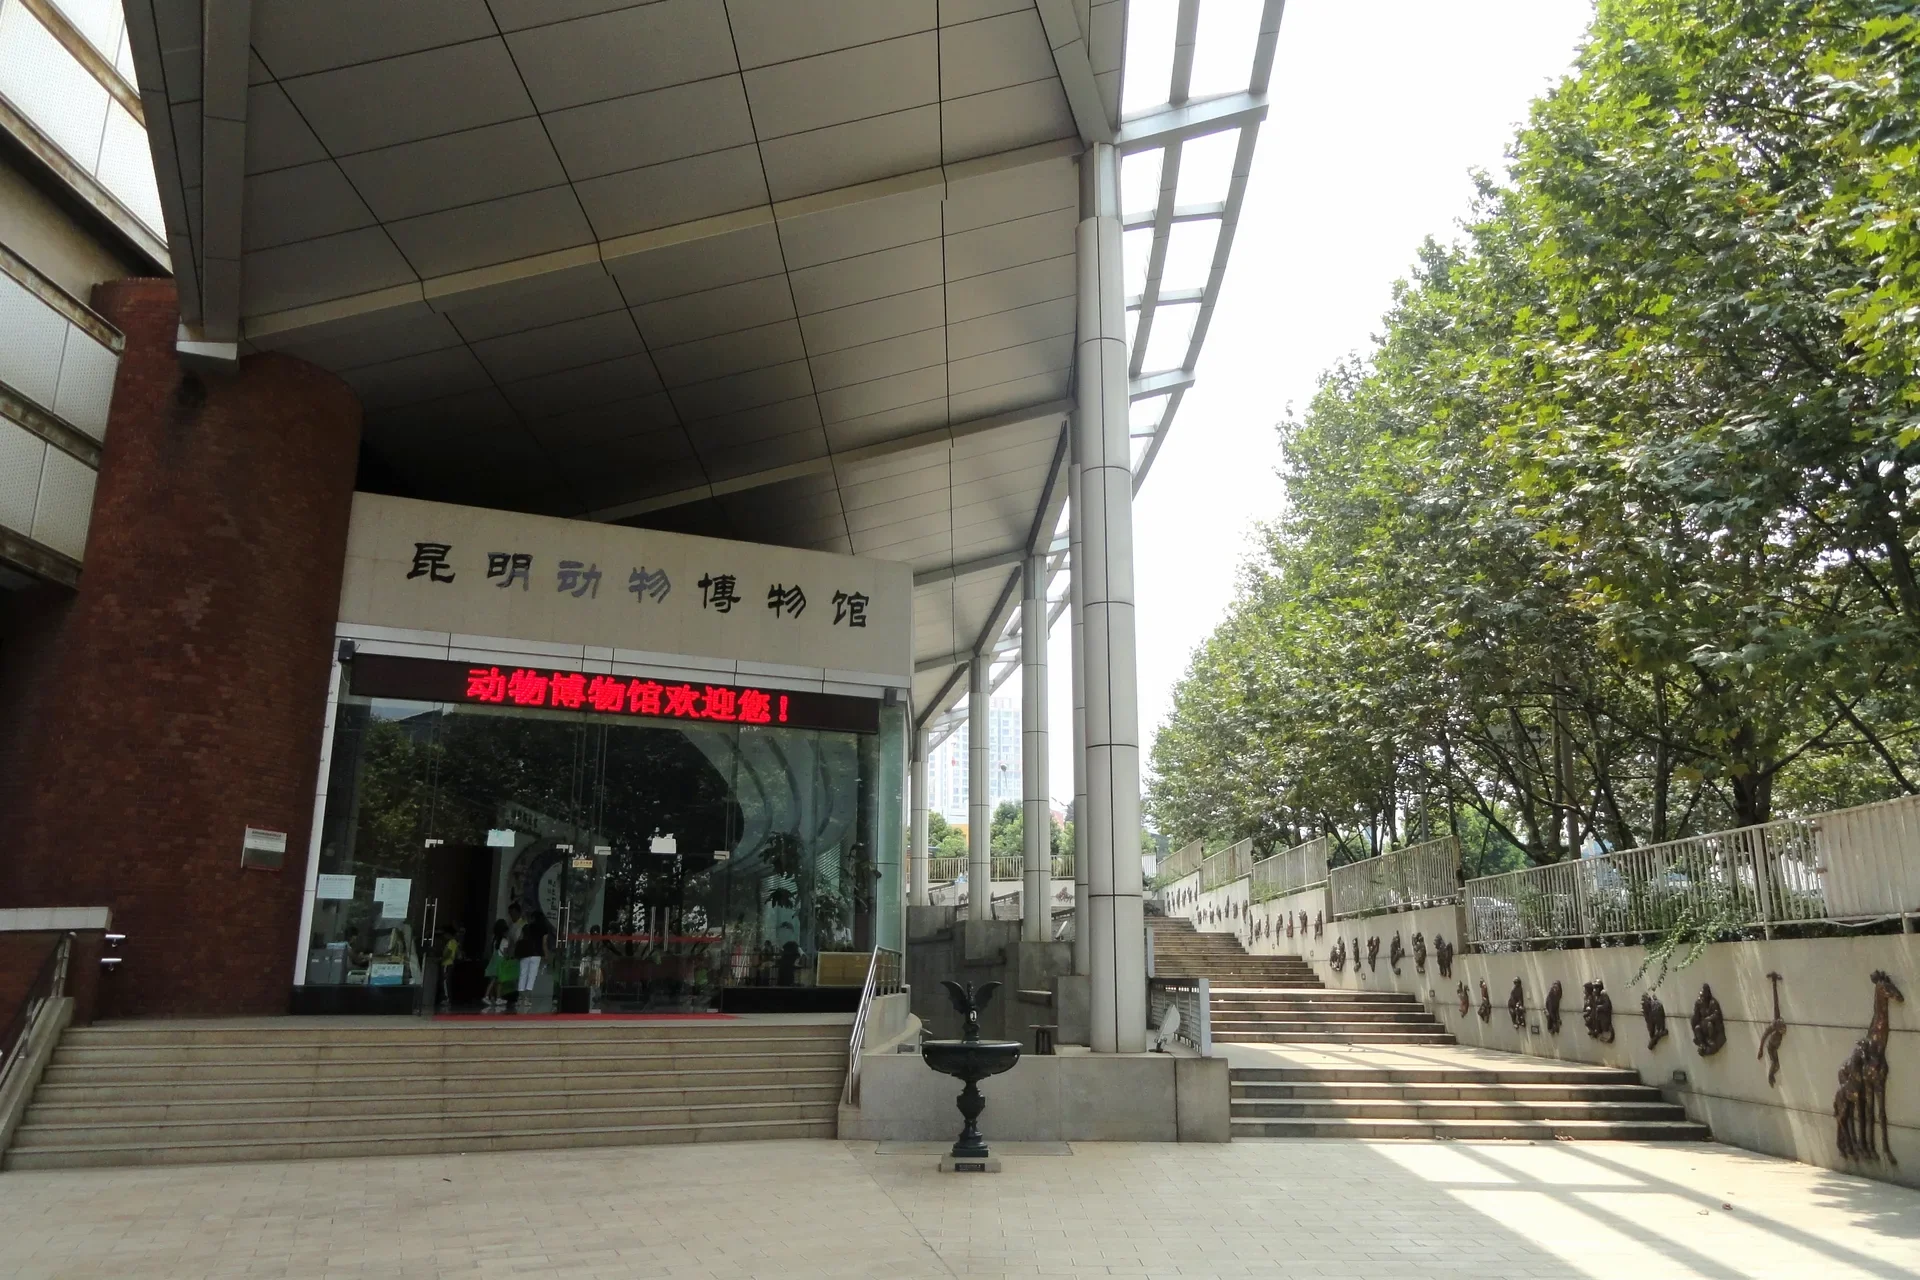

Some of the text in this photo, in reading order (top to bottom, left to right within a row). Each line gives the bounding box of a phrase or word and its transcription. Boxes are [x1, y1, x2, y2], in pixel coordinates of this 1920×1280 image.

[407, 542, 869, 627] 昆明动物博物馆
